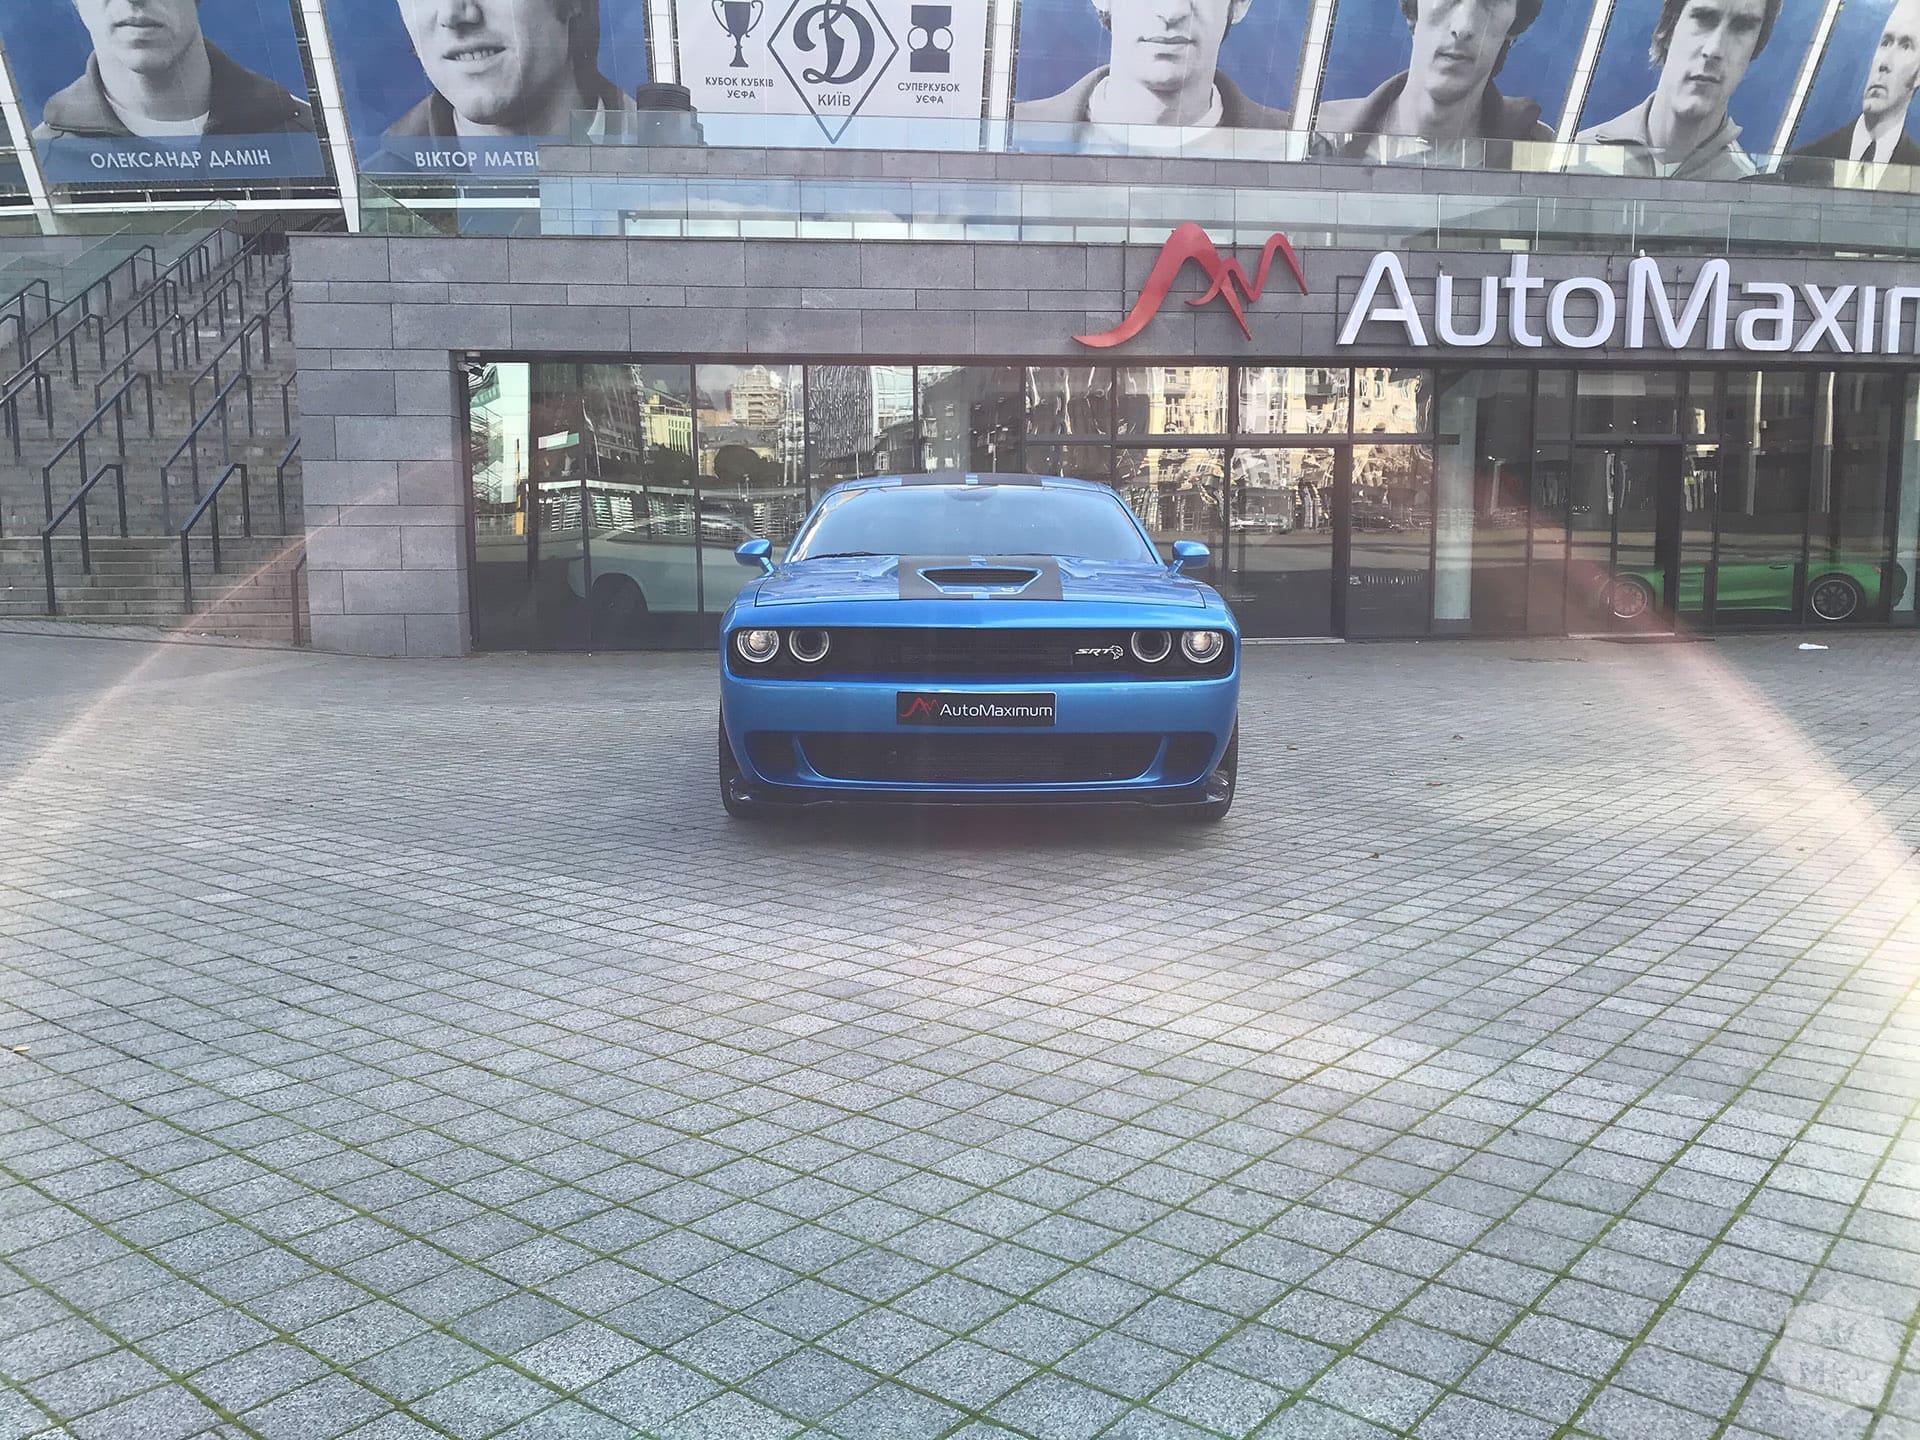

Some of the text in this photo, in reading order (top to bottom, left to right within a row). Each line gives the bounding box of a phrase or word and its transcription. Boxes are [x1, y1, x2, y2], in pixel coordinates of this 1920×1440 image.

[705, 76, 775, 88] КУБОК КУБКІВ
[897, 82, 960, 92] СУПЕРКУБОК
[727, 89, 756, 99] УЄФА
[817, 92, 851, 107] КИЇВ
[915, 95, 944, 104] УЄФА
[90, 149, 271, 169] ОЛЕКСАНДР ДАМІН
[414, 151, 478, 168] ВІКТОР
[1075, 648, 1113, 657] SRT
[939, 703, 1053, 717] AutoMaximum
